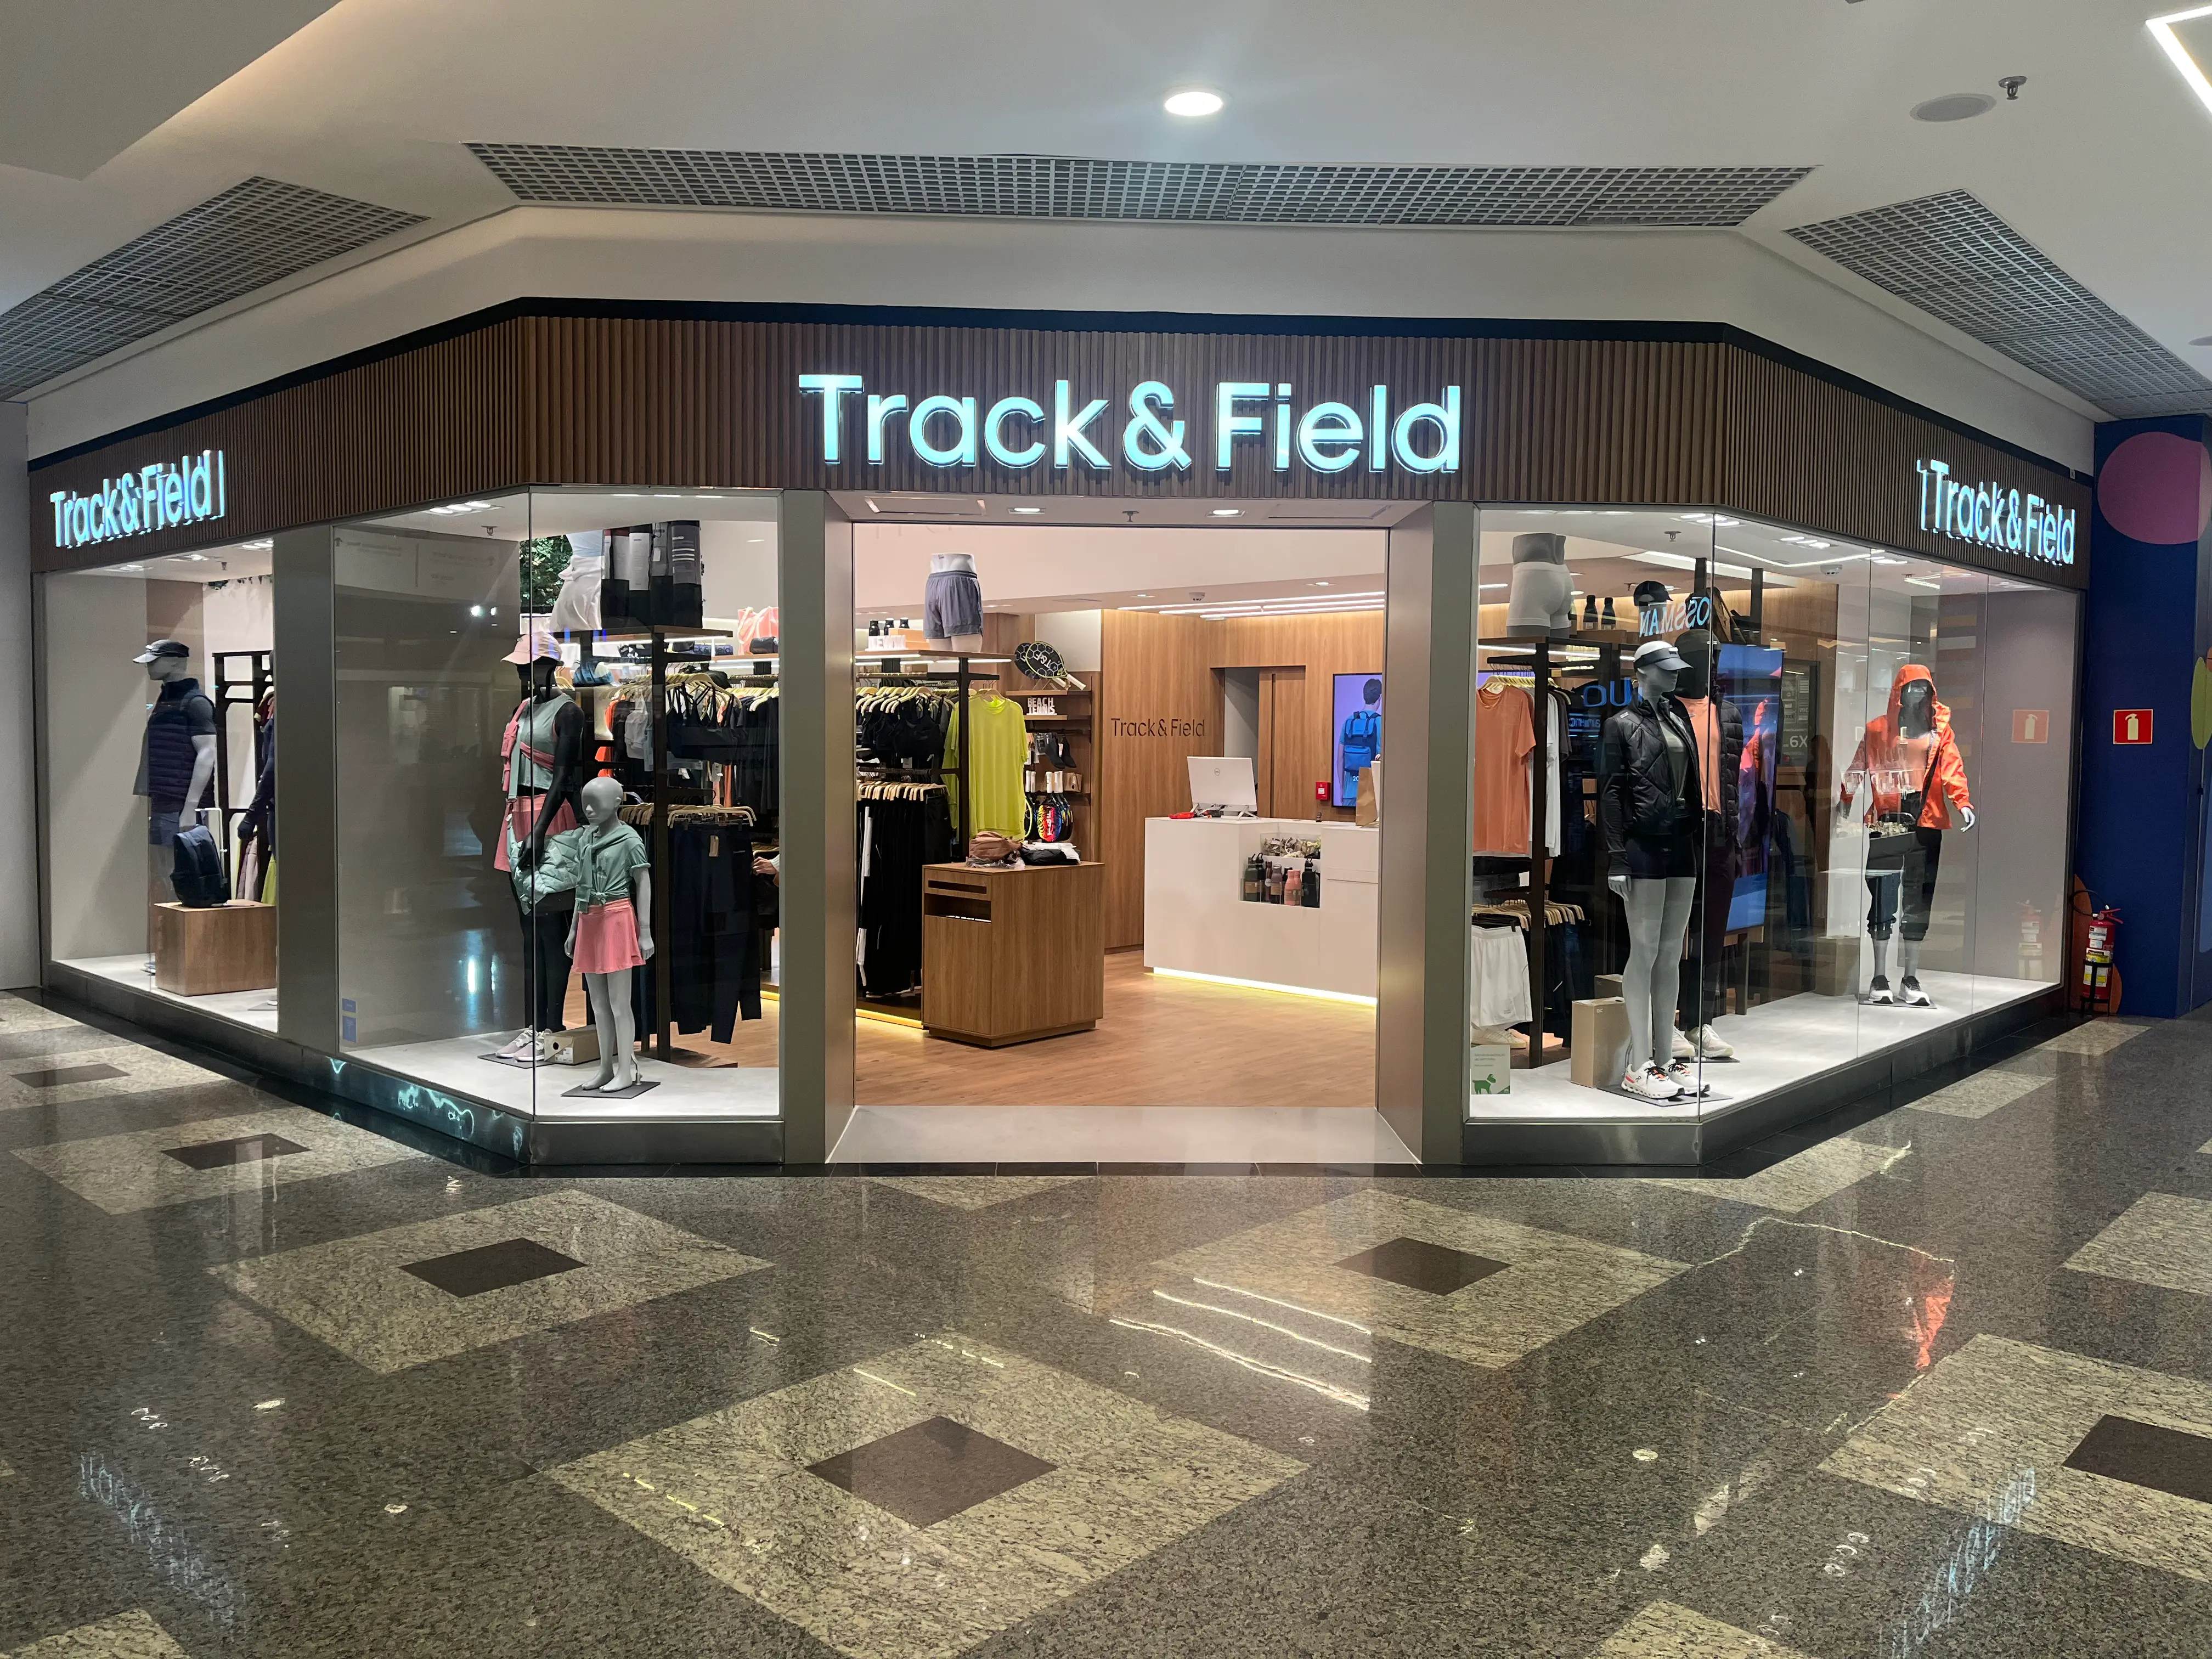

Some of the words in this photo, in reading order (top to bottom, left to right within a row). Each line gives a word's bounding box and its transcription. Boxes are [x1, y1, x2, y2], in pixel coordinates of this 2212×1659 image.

[798, 374, 1112, 471] Track
[1122, 380, 1193, 472] &
[1215, 381, 1461, 475] Field
[50, 478, 121, 548] Track
[142, 450, 213, 528] Field
[1928, 459, 2005, 546] Track
[2025, 493, 2076, 565] Field
[1033, 653, 1052, 669] T&F
[1028, 697, 1054, 708] BEACH
[1028, 705, 1056, 714] TENNIS
[1110, 718, 1155, 737] Track
[1158, 718, 1167, 737] &
[1171, 718, 1205, 737] Field
[1790, 735, 1808, 748] 6X
